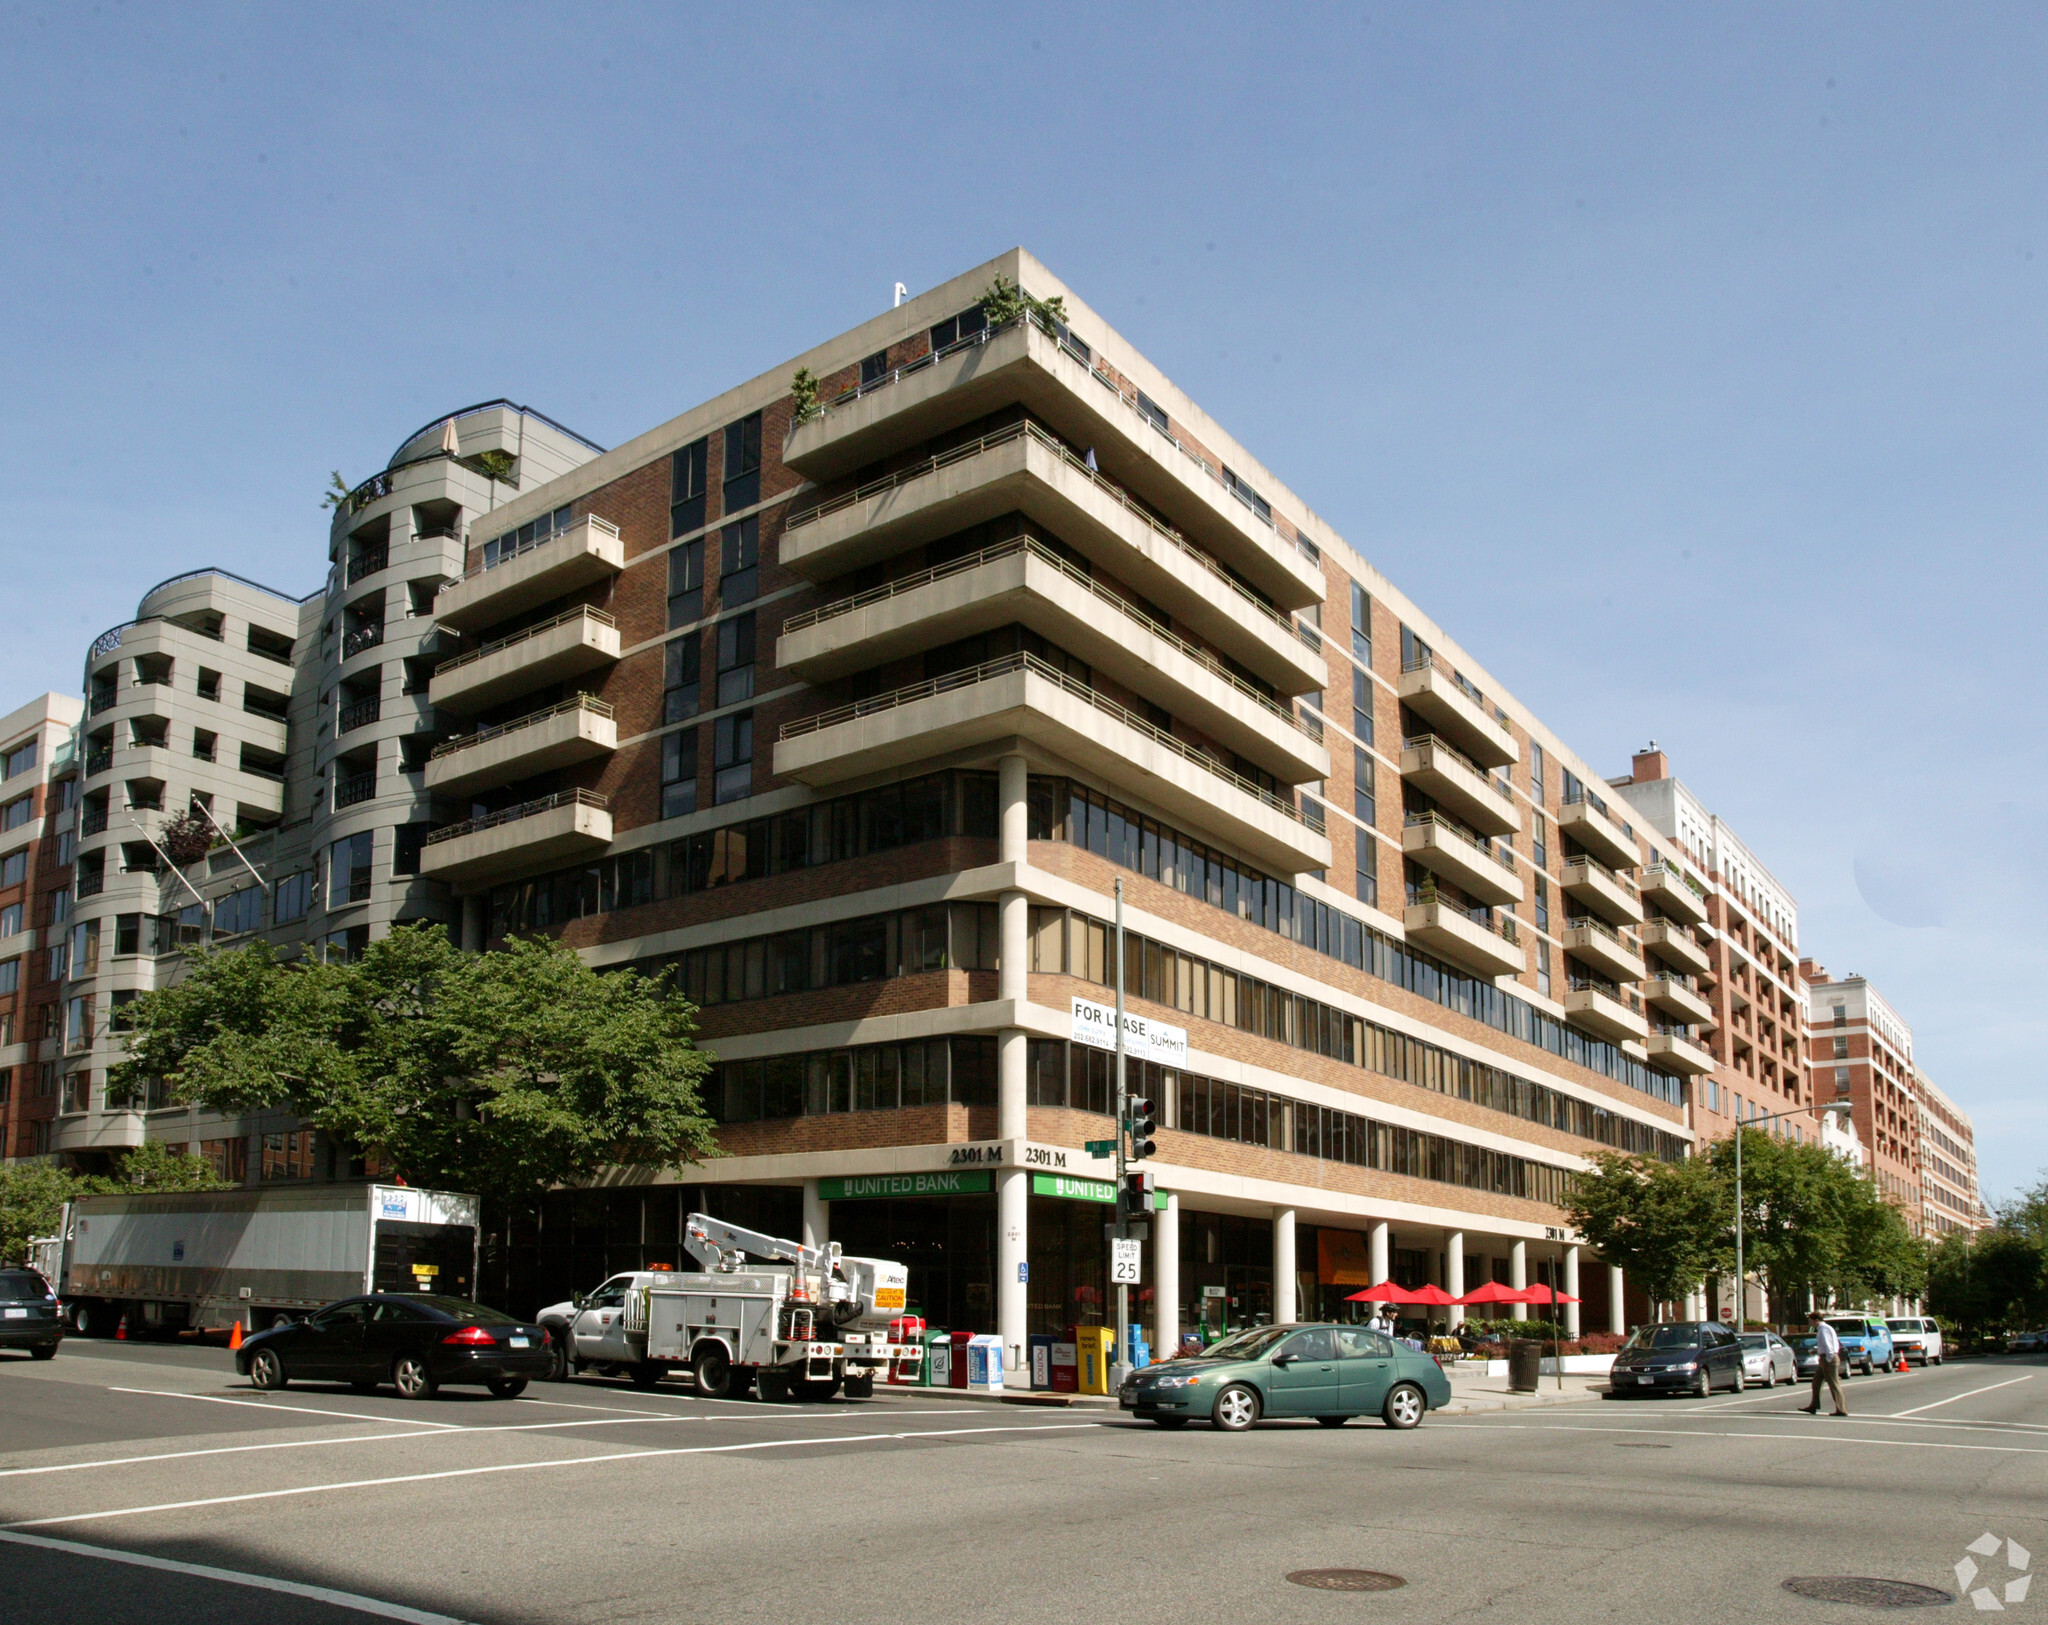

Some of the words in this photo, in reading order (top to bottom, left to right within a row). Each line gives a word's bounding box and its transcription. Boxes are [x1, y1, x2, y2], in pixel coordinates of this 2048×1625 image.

[1075, 1003, 1102, 1024] FOR
[1150, 1033, 1185, 1053] SUMMIT
[951, 1147, 983, 1164] 2301
[987, 1145, 1003, 1162] M
[1025, 1147, 1051, 1166] 2301
[1054, 1152, 1067, 1168] M
[855, 1176, 912, 1194] UNITED
[916, 1174, 960, 1192] BANK
[1065, 1178, 1114, 1200] UNITED
[1116, 1243, 1138, 1251] SPEED
[887, 1275, 904, 1283] Altec
[1117, 1262, 1136, 1279] 25
